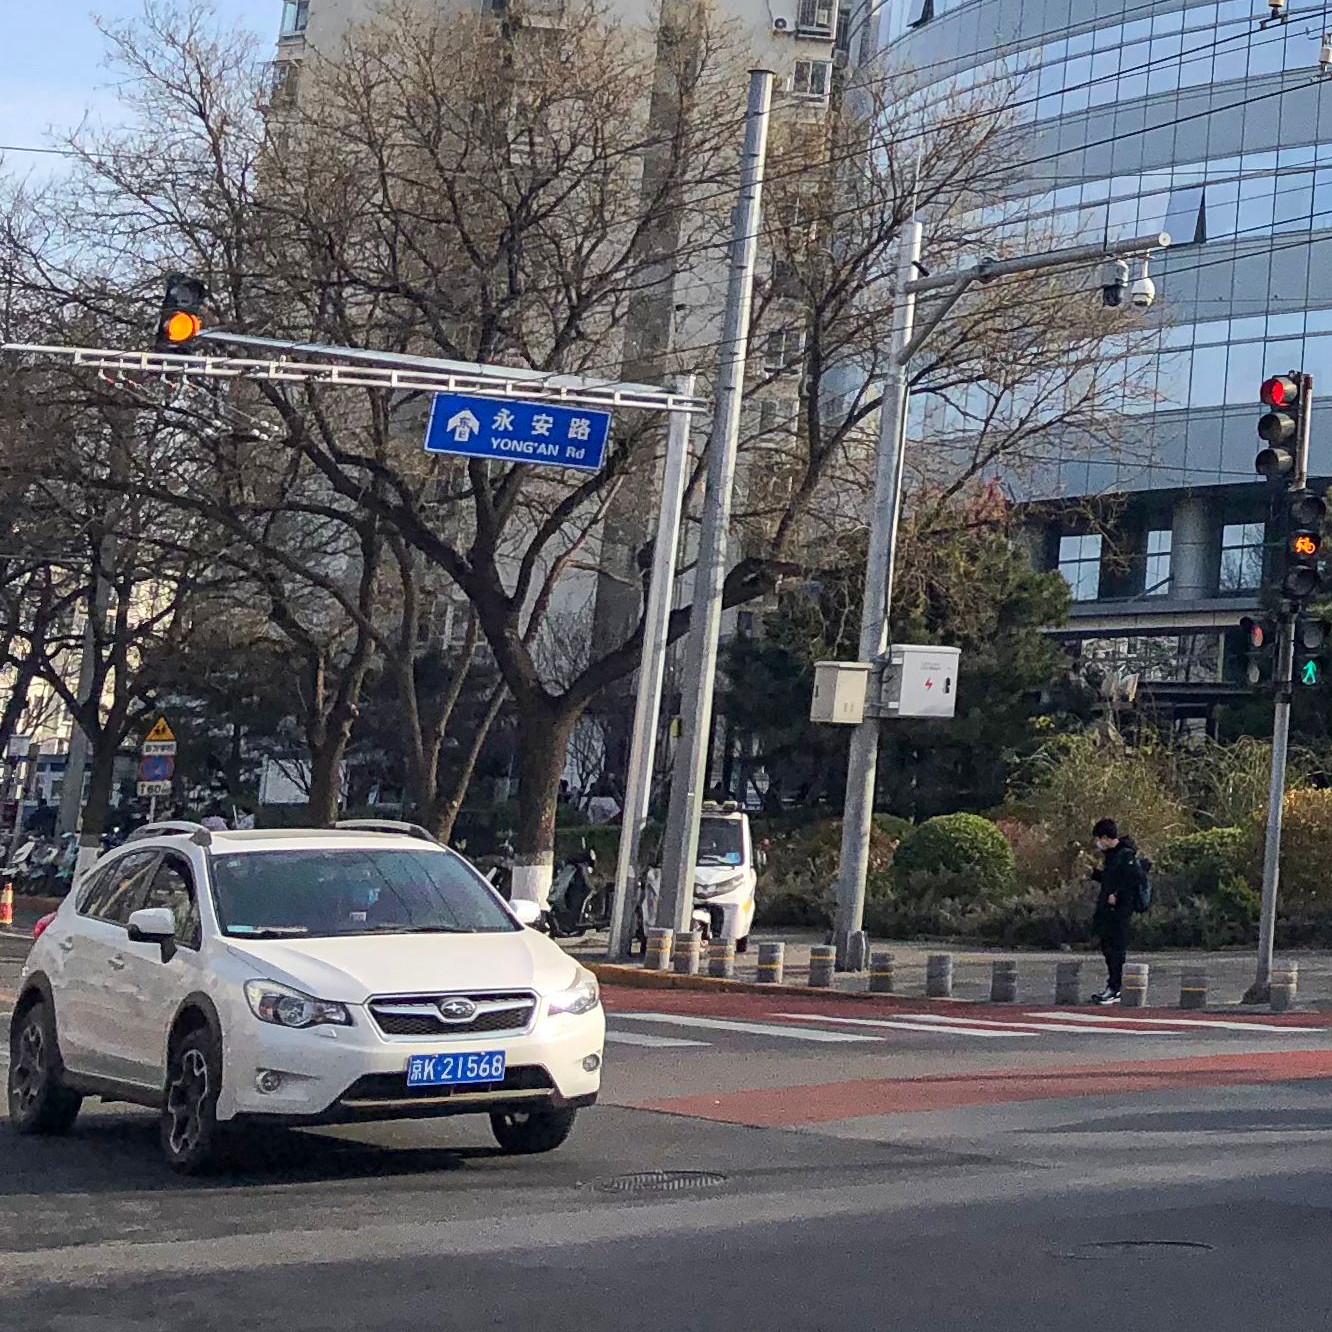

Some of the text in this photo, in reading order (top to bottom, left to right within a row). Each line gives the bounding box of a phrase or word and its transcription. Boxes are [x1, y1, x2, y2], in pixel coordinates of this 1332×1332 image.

[491, 408, 591, 441] 永安路
[490, 437, 586, 460] YONG'AN Rd
